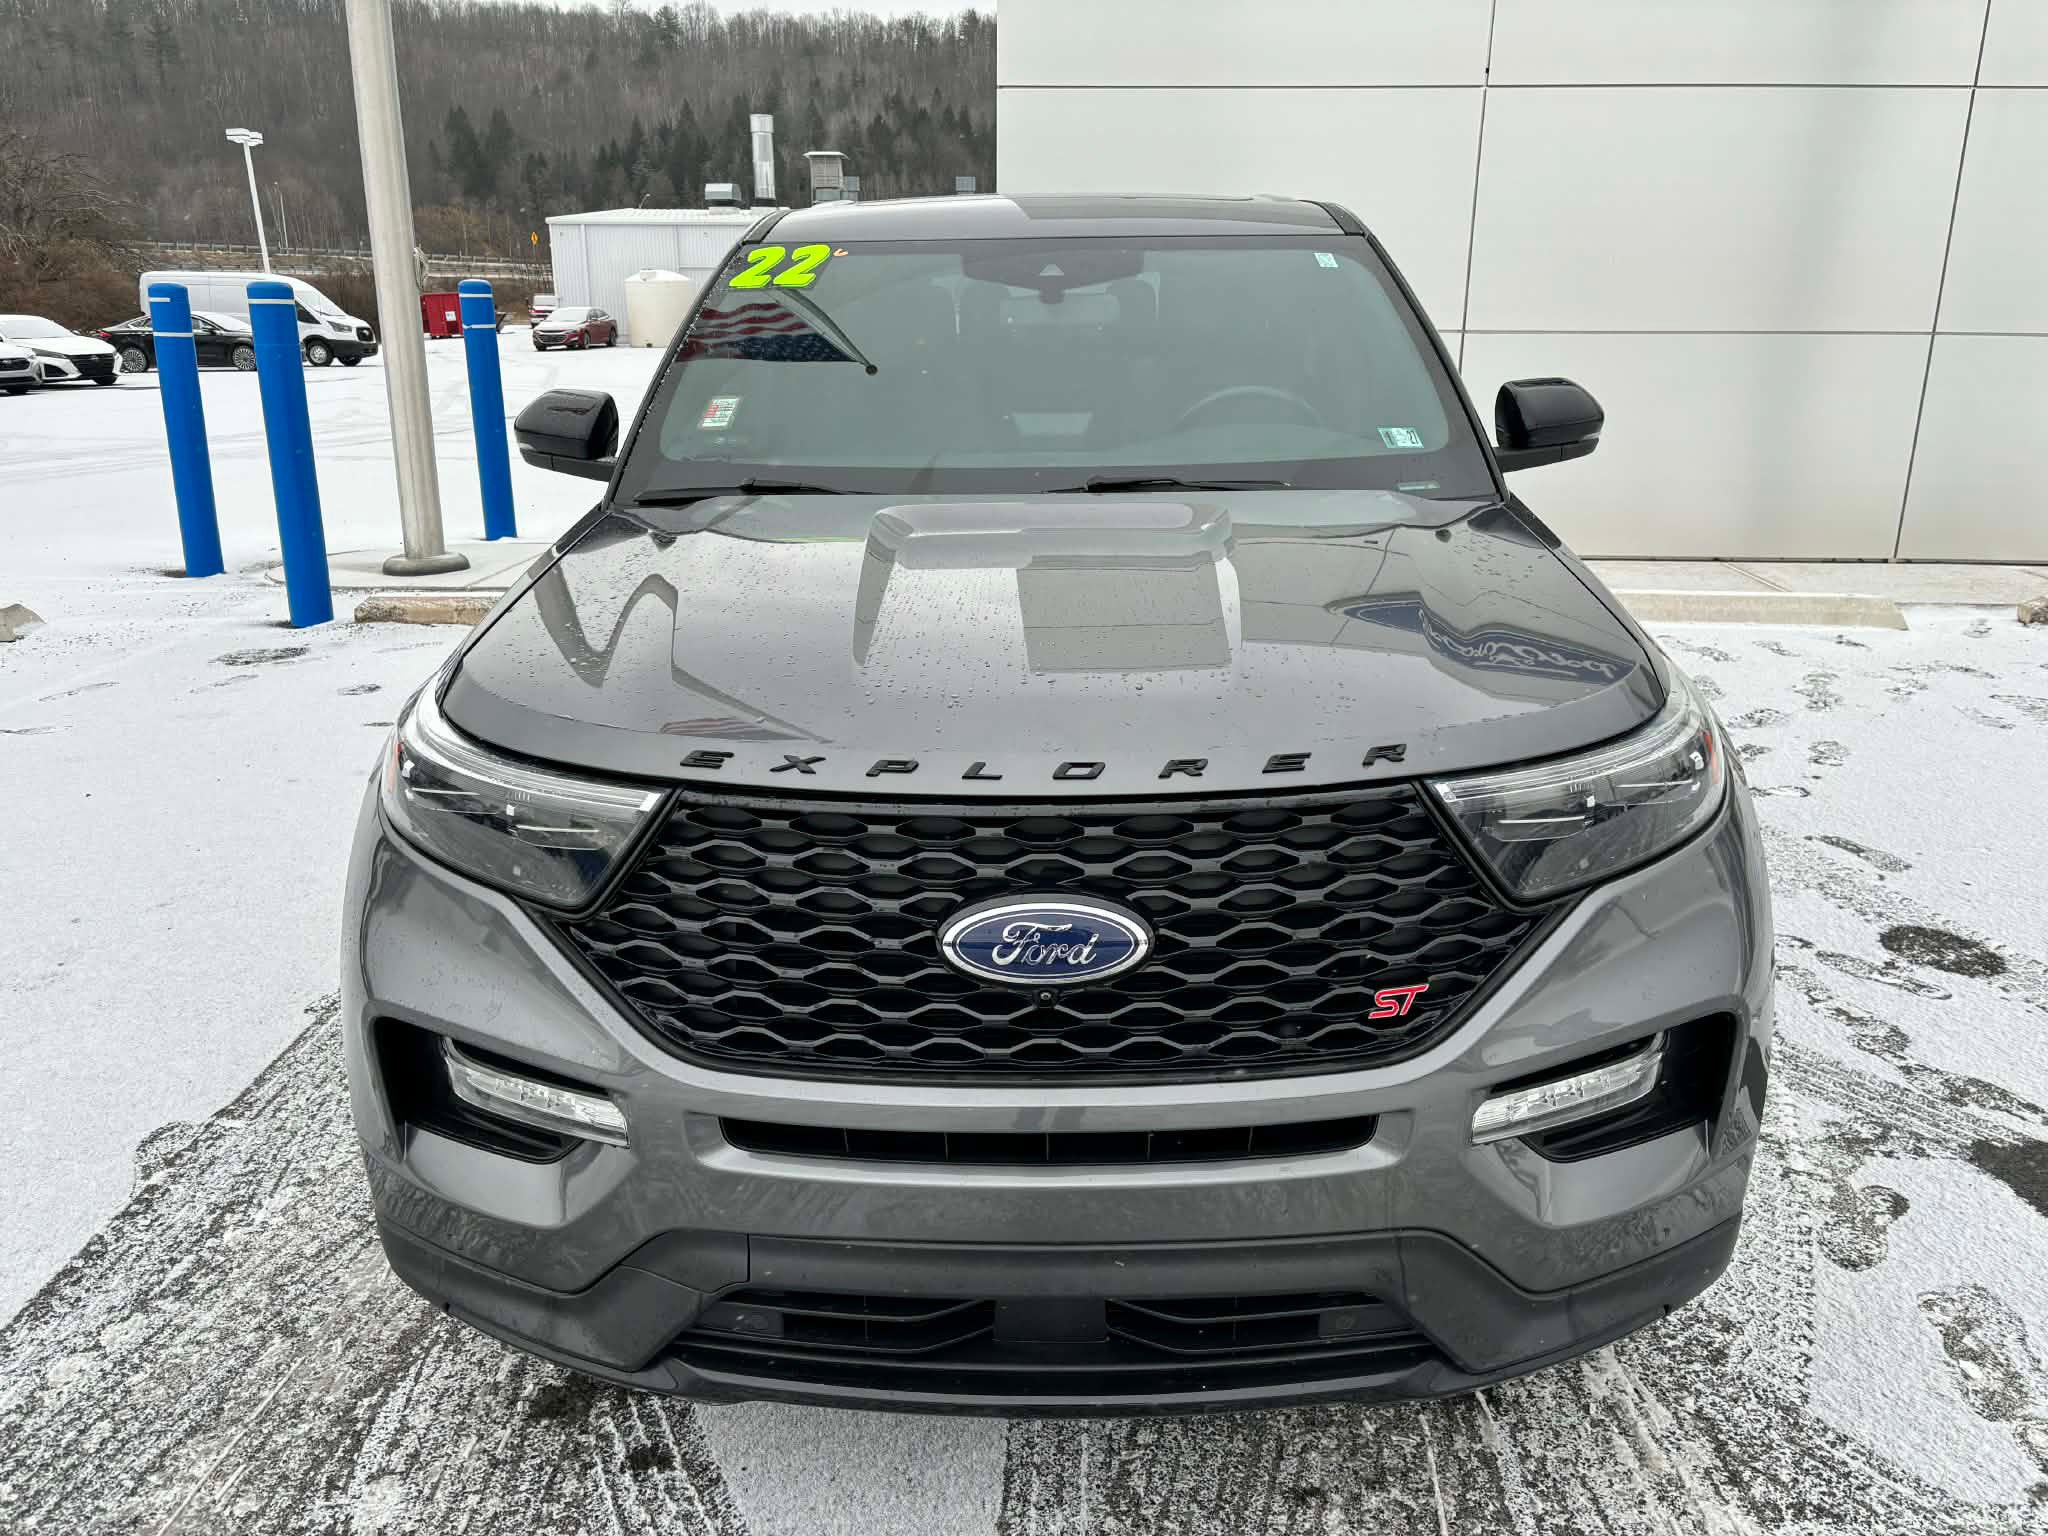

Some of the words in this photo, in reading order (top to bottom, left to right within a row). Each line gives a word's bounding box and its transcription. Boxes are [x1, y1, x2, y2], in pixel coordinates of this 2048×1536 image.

[729, 244, 831, 288] 22
[680, 743, 1407, 780] EXPLORER
[991, 921, 1100, 966] Ford
[1368, 983, 1429, 1019] ST
